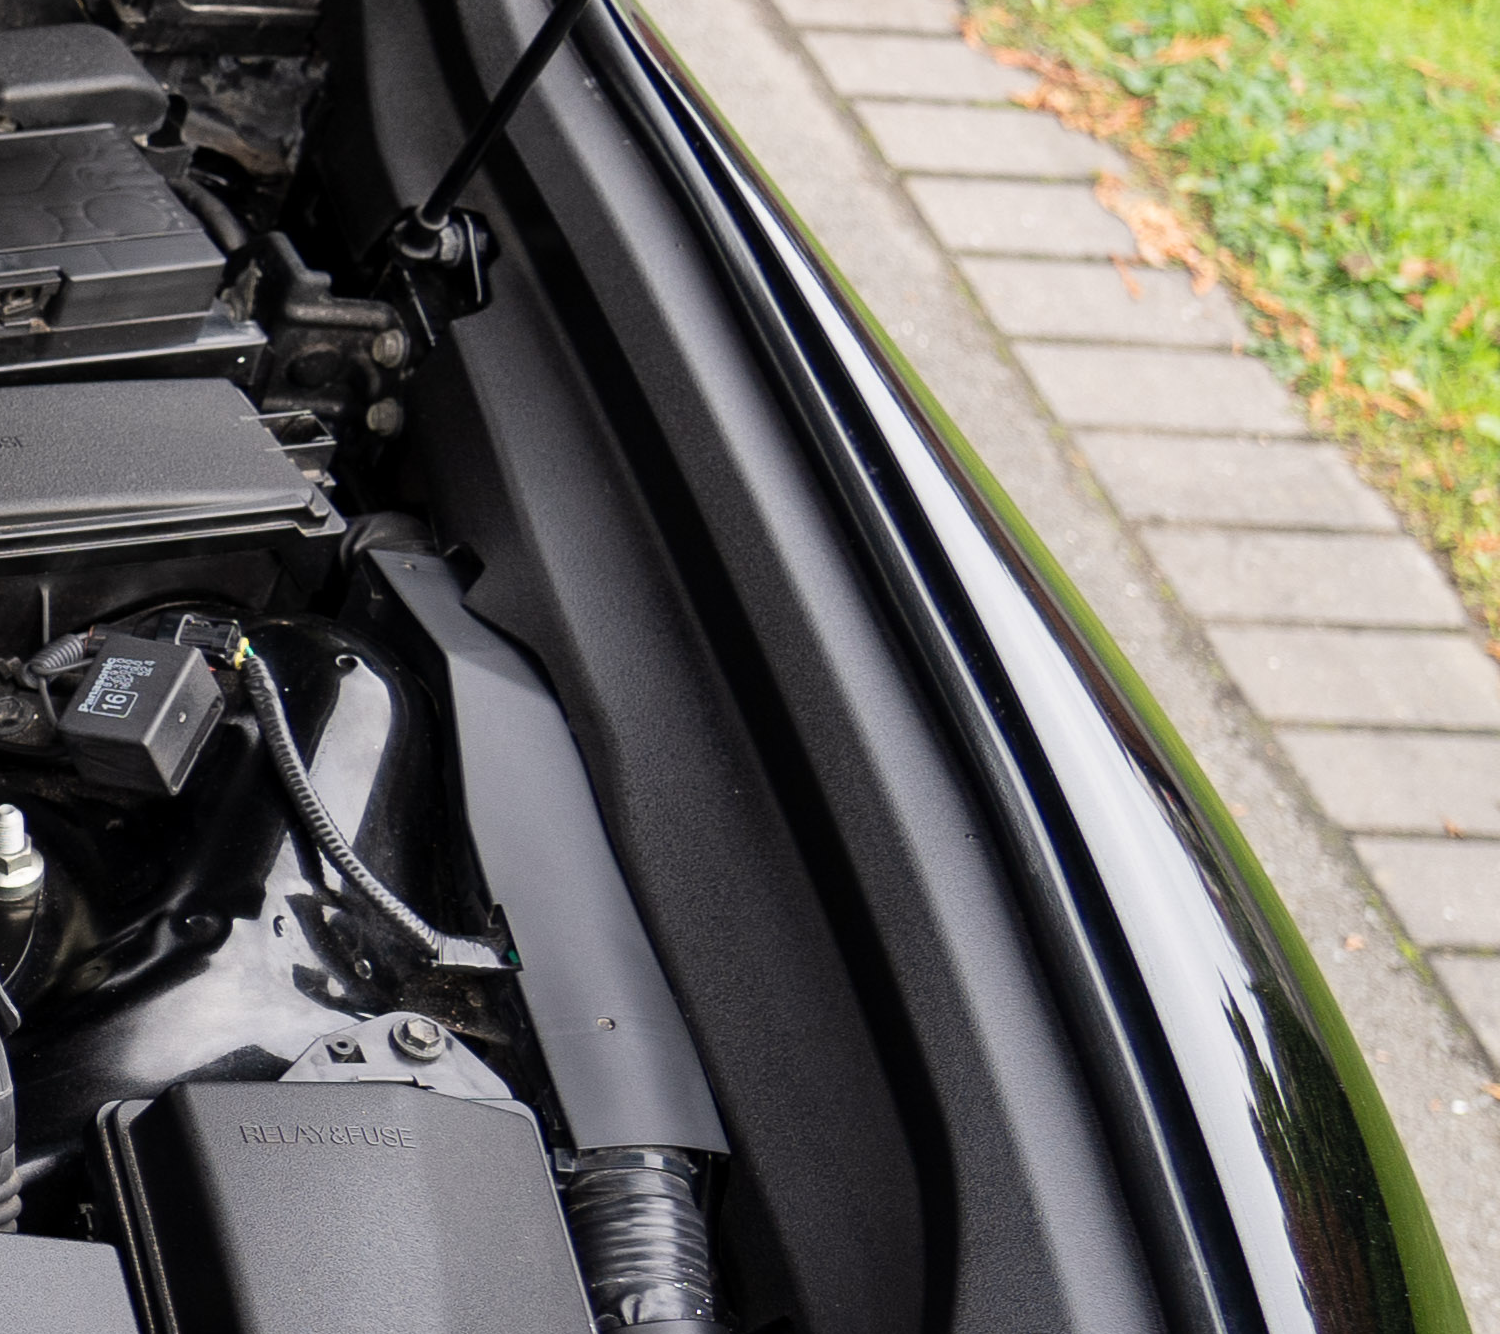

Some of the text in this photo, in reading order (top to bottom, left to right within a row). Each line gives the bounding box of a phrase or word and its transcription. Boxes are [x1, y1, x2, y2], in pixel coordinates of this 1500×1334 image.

[76, 656, 116, 713] Panasonic
[101, 692, 127, 710] 16
[239, 1124, 417, 1149] RELAY&FUSE
